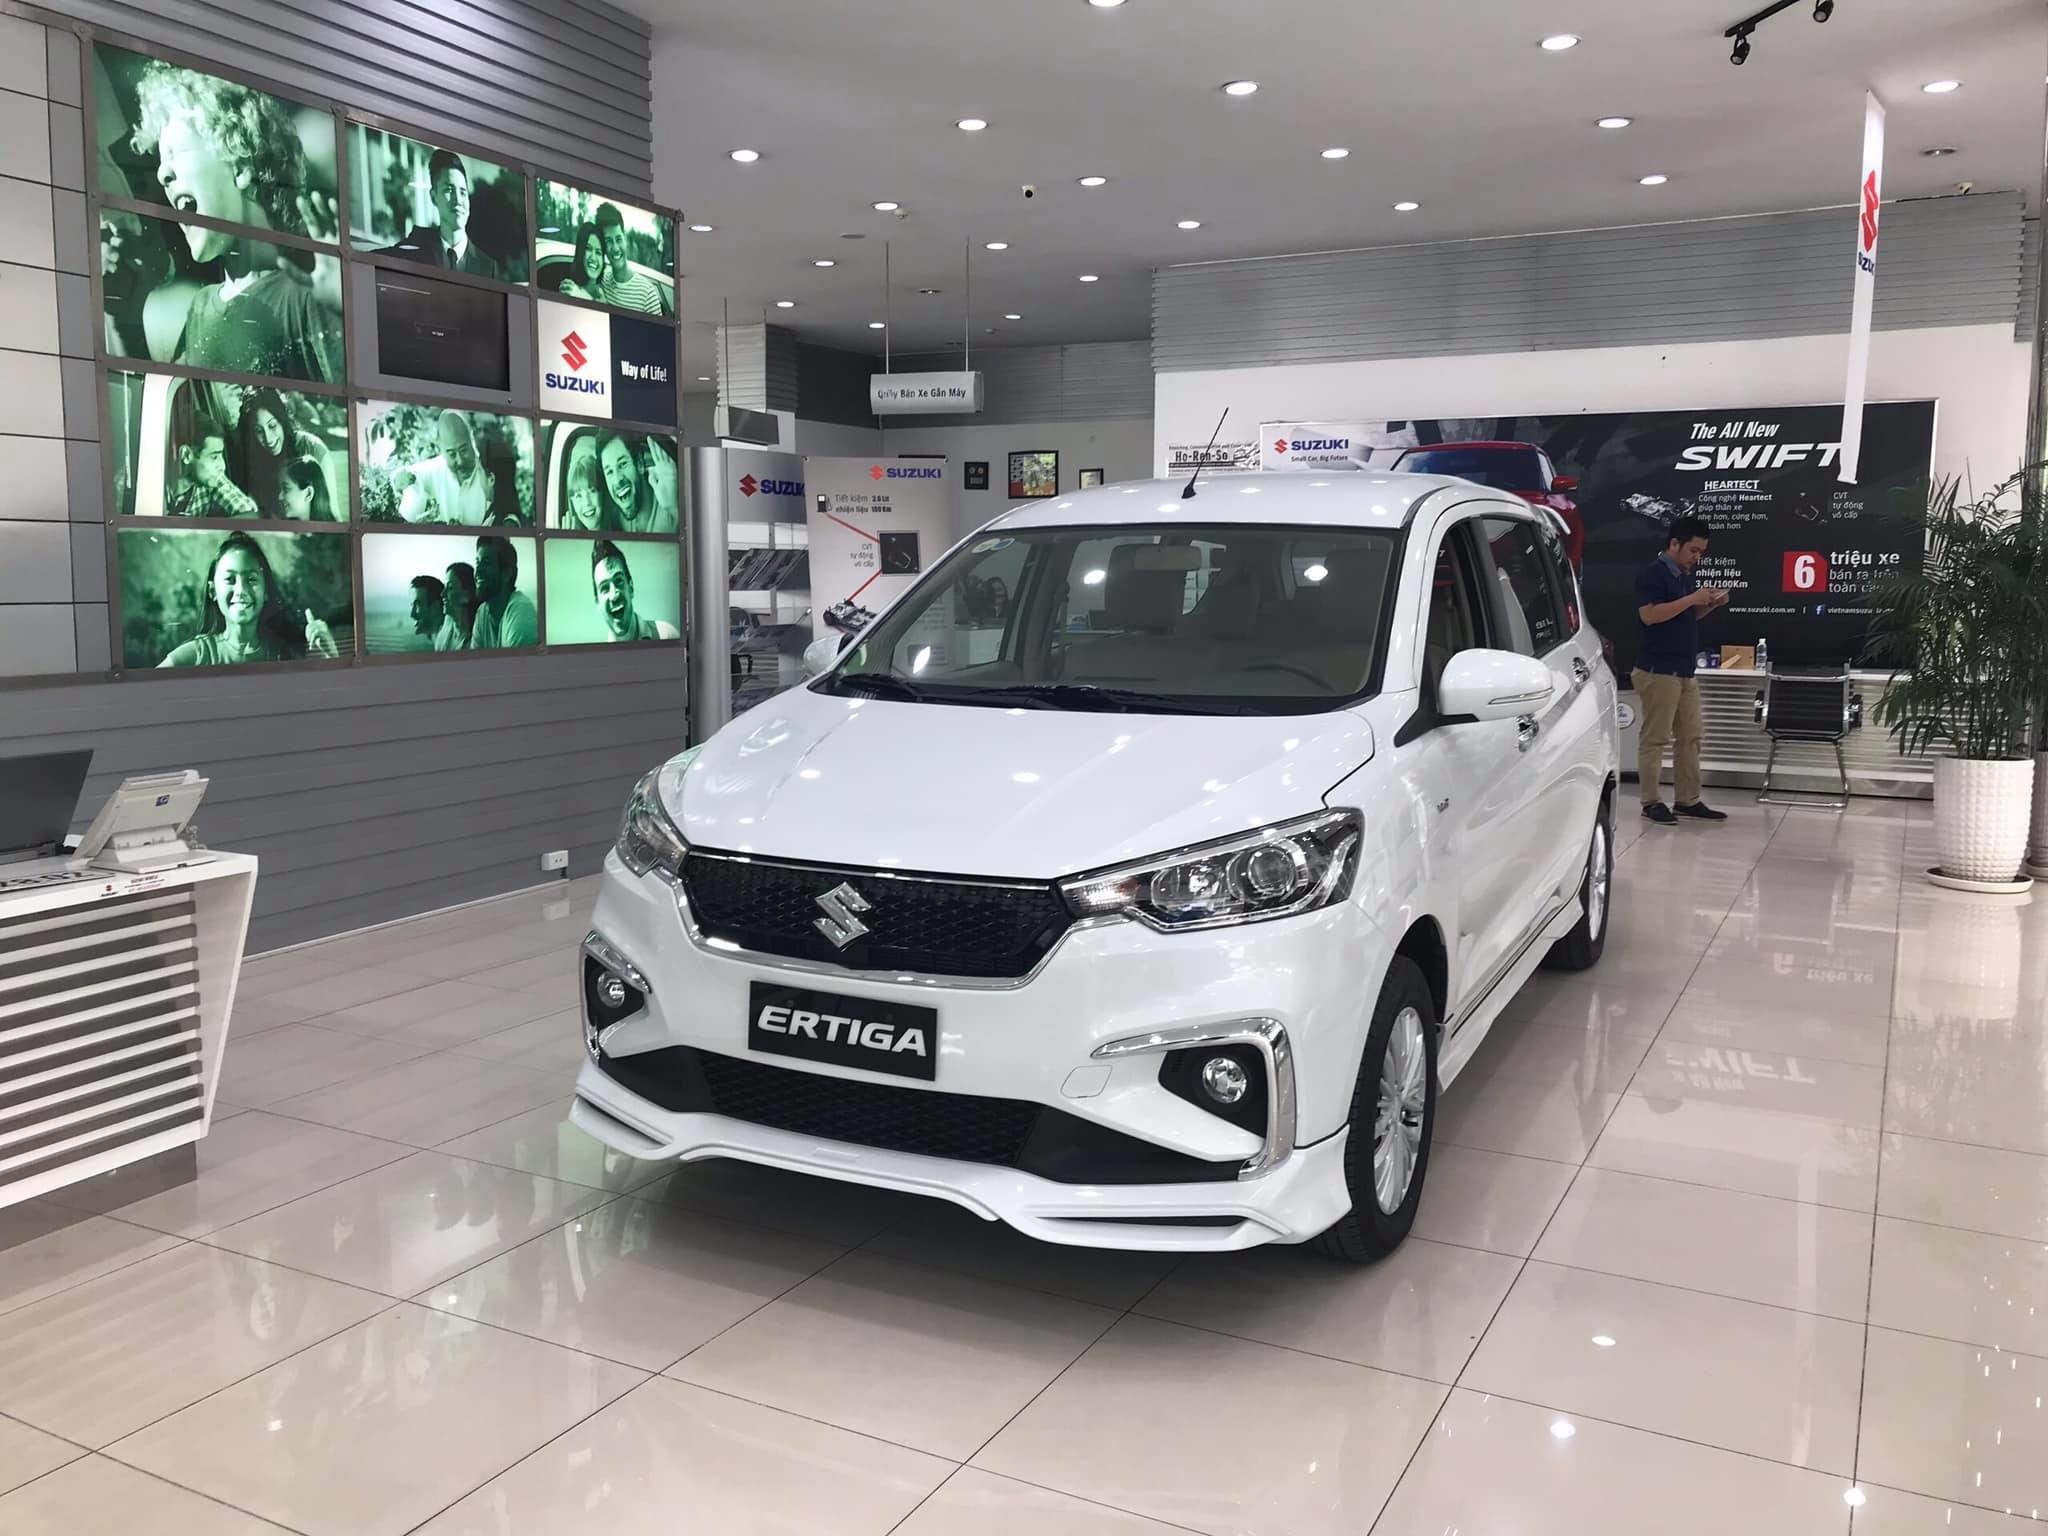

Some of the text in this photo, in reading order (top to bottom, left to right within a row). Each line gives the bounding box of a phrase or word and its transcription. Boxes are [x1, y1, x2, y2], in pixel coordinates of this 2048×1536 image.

[621, 360, 668, 382] Way of Life!
[545, 373, 605, 395] SUZUKI
[918, 388, 928, 398] Xe
[1690, 420, 1780, 439] The All New
[1291, 439, 1349, 451] SUZUKI
[1674, 442, 1842, 471] SWIFT
[886, 467, 942, 479] SUZUKI
[1704, 479, 1760, 491] HEARTECT
[1833, 491, 1848, 499] CVT
[1714, 557, 1736, 567] kiệm
[1830, 550, 1900, 568] triệu xe
[1724, 568, 1741, 578] liệu
[1794, 555, 1815, 588] 6
[1829, 568, 1852, 580] bán
[1829, 581, 1856, 592] toàn
[757, 1005, 927, 1057] ERTIGA
